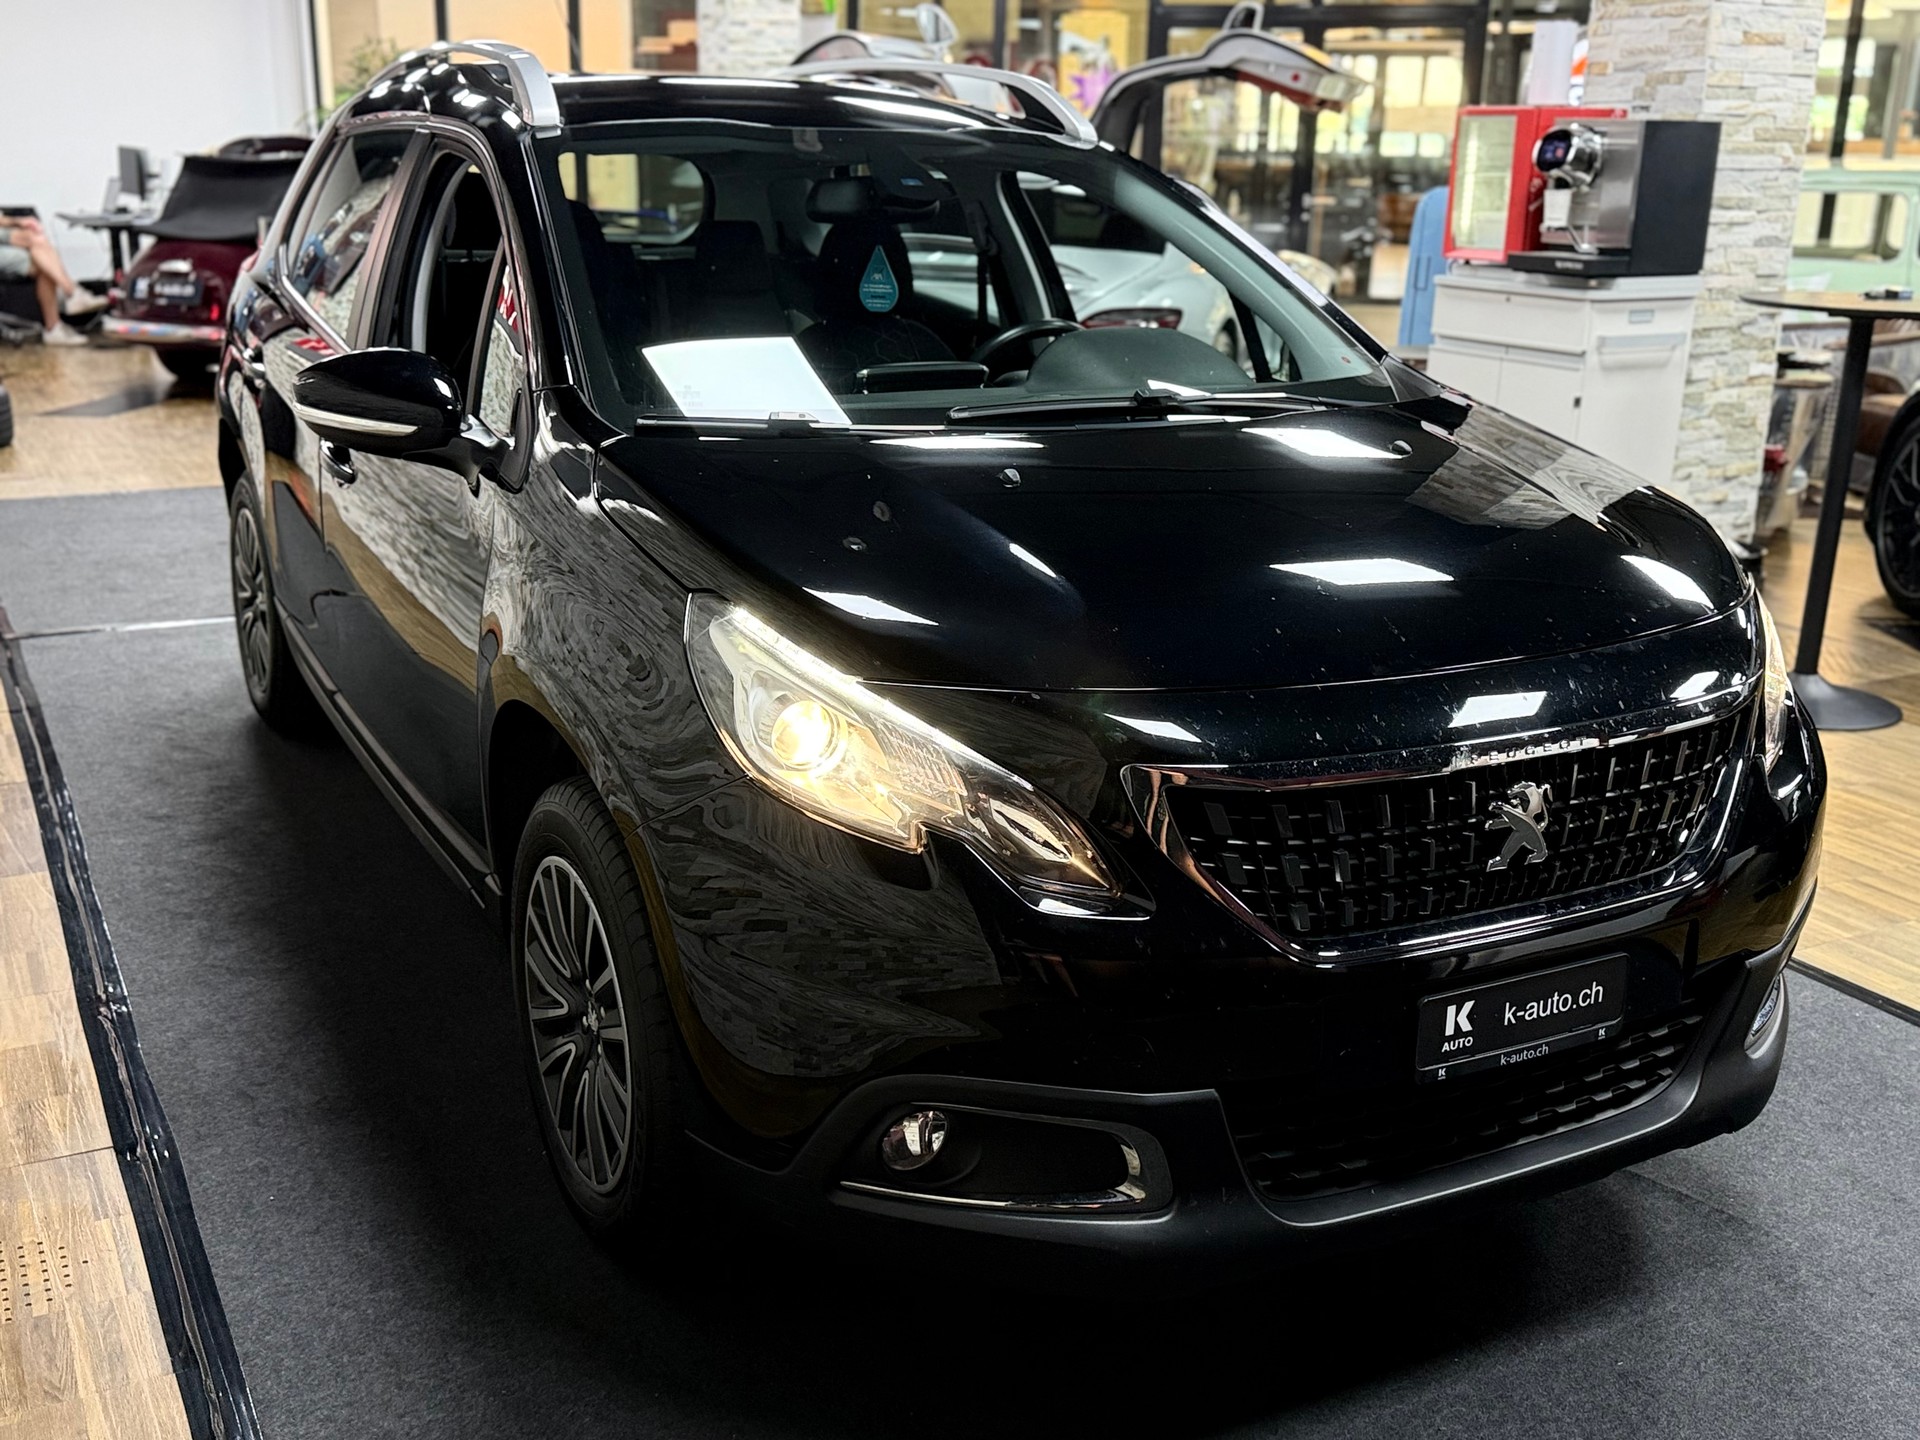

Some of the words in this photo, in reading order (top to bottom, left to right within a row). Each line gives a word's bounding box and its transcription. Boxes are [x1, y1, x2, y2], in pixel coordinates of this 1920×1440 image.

[1470, 736, 1587, 765] PEUGEOT
[1444, 1000, 1475, 1036] K
[1503, 981, 1604, 1026] k-auto.ch
[1441, 1036, 1474, 1053] AUTO
[1500, 1044, 1549, 1066] k-auto.ch
